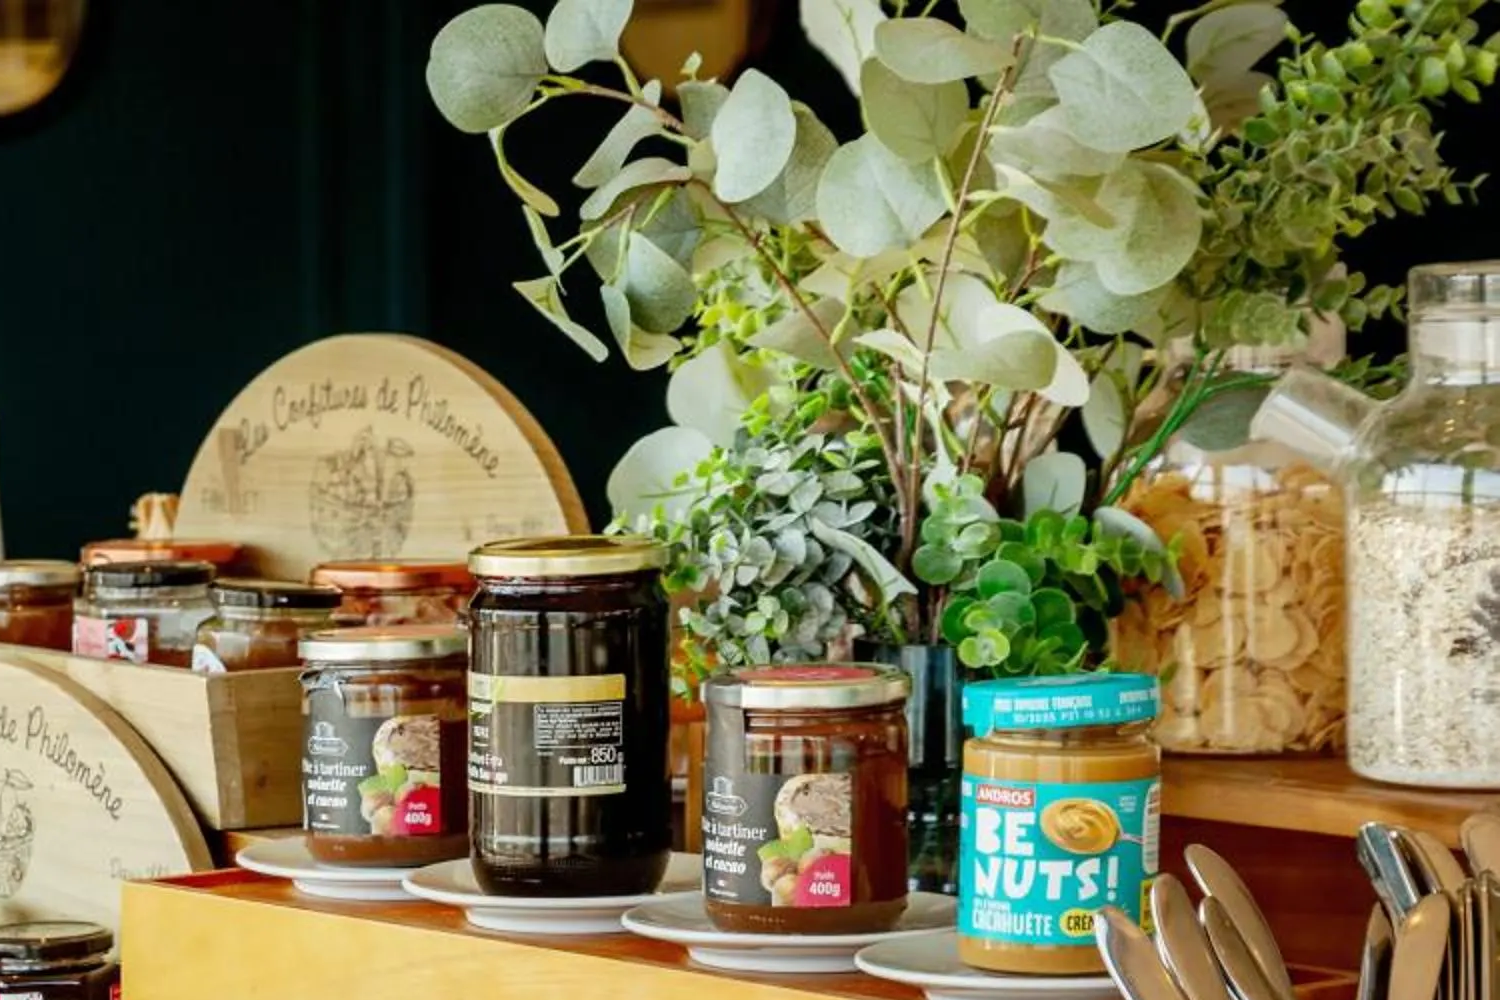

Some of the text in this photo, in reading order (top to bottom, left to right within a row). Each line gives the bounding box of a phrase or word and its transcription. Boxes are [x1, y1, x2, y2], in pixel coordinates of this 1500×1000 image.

[272, 377, 368, 432] Confitures
[376, 376, 400, 415] de
[24, 704, 125, 821] Philomène
[591, 747, 617, 763] 850
[319, 760, 367, 777] tartiner
[977, 785, 1031, 805] ANDROS
[404, 812, 432, 827] 400g
[717, 821, 768, 840] tartiner
[975, 807, 1036, 857] BE
[974, 855, 1119, 902] NUTS!
[808, 882, 841, 897] 400g
